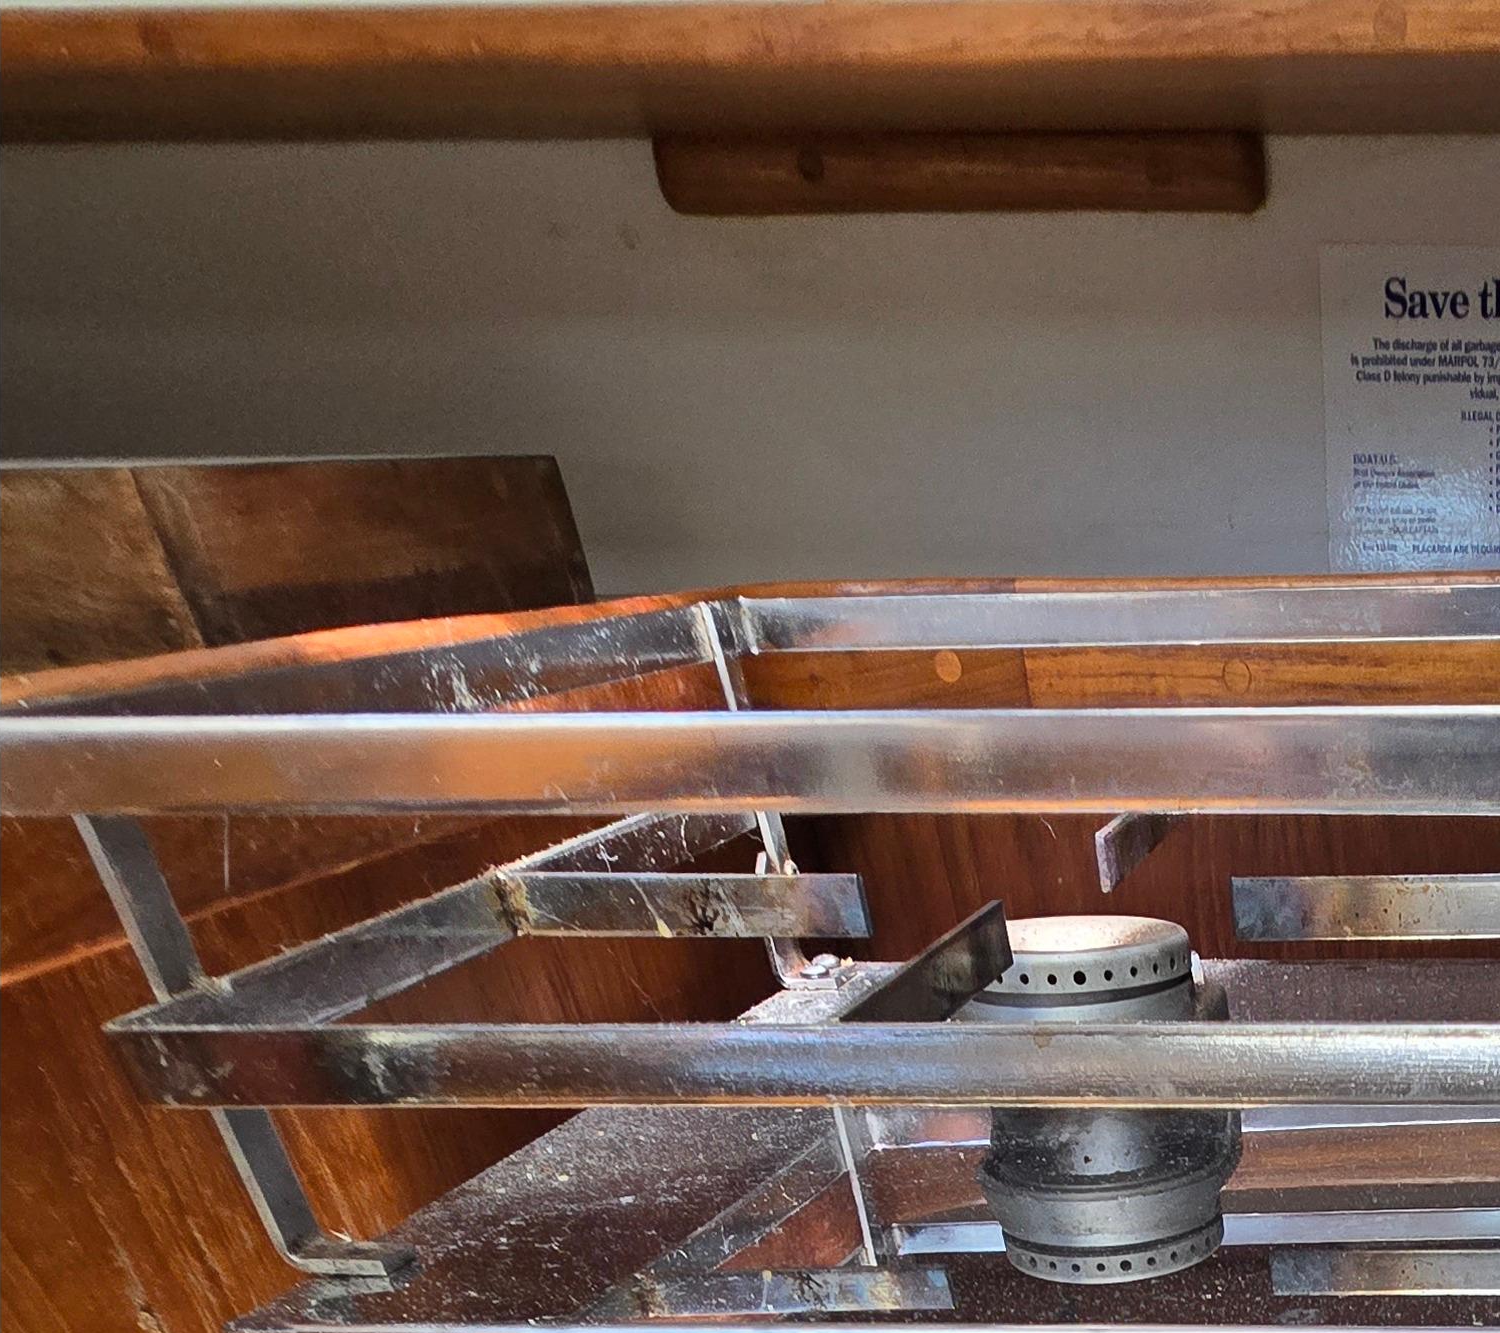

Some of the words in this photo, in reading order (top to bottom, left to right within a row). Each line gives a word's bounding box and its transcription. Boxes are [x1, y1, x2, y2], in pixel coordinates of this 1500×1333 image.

[1384, 276, 1470, 320] Save
[1373, 337, 1390, 351] The
[1392, 337, 1438, 353] discharge
[1440, 338, 1449, 351] of
[1451, 338, 1462, 352] all
[1361, 353, 1408, 368] prohibited
[1409, 354, 1435, 367] under
[1438, 355, 1479, 368] MARPOL
[1356, 370, 1381, 383] Class
[1384, 370, 1391, 382] D
[1393, 371, 1420, 385] felony
[1422, 372, 1471, 386] punishable
[1474, 372, 1484, 385] by
[1461, 410, 1493, 422] ILLEGAL
